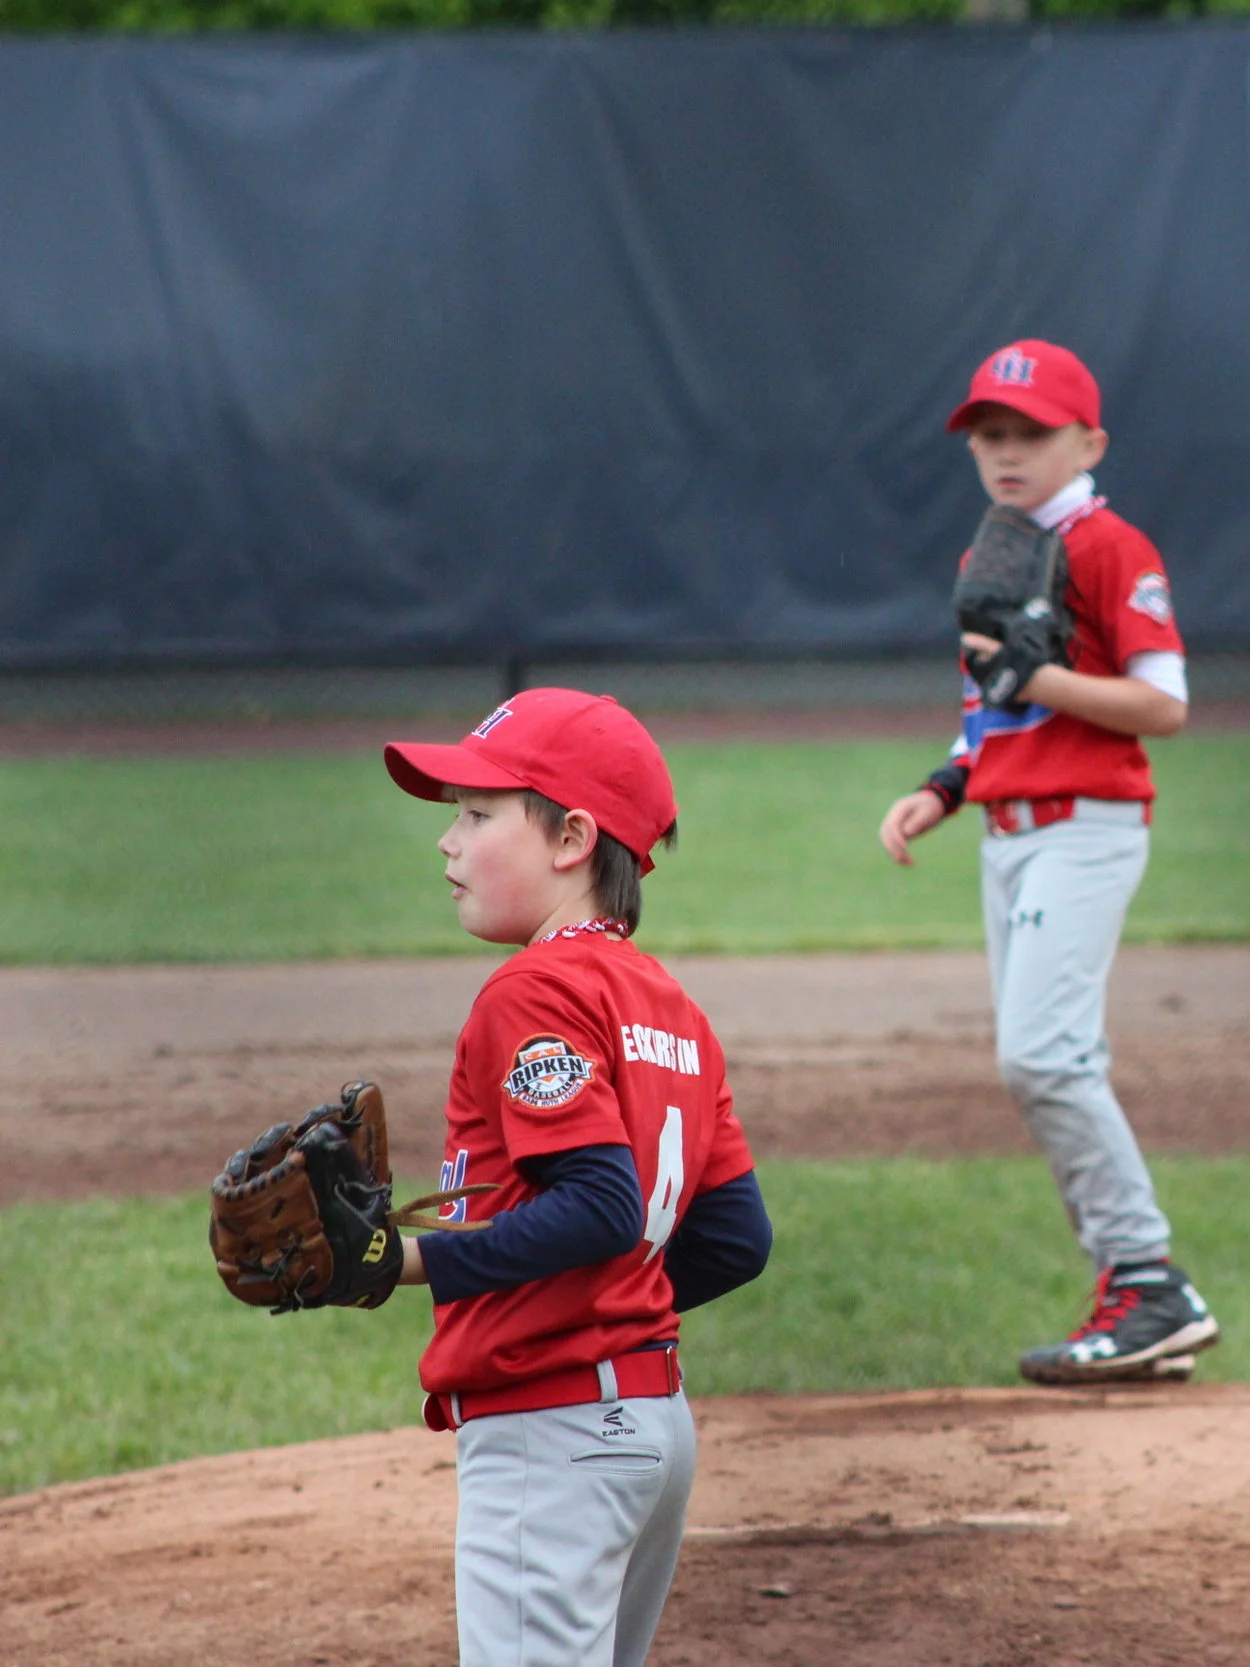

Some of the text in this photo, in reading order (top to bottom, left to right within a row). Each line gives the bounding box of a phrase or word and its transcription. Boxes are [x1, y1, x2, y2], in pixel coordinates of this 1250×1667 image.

[525, 1046, 561, 1060] CAL
[511, 1057, 584, 1090] RIPKEN
[528, 1079, 574, 1099] BASEBALL
[642, 1105, 685, 1265] 4
[602, 1428, 636, 1437] EASTON
